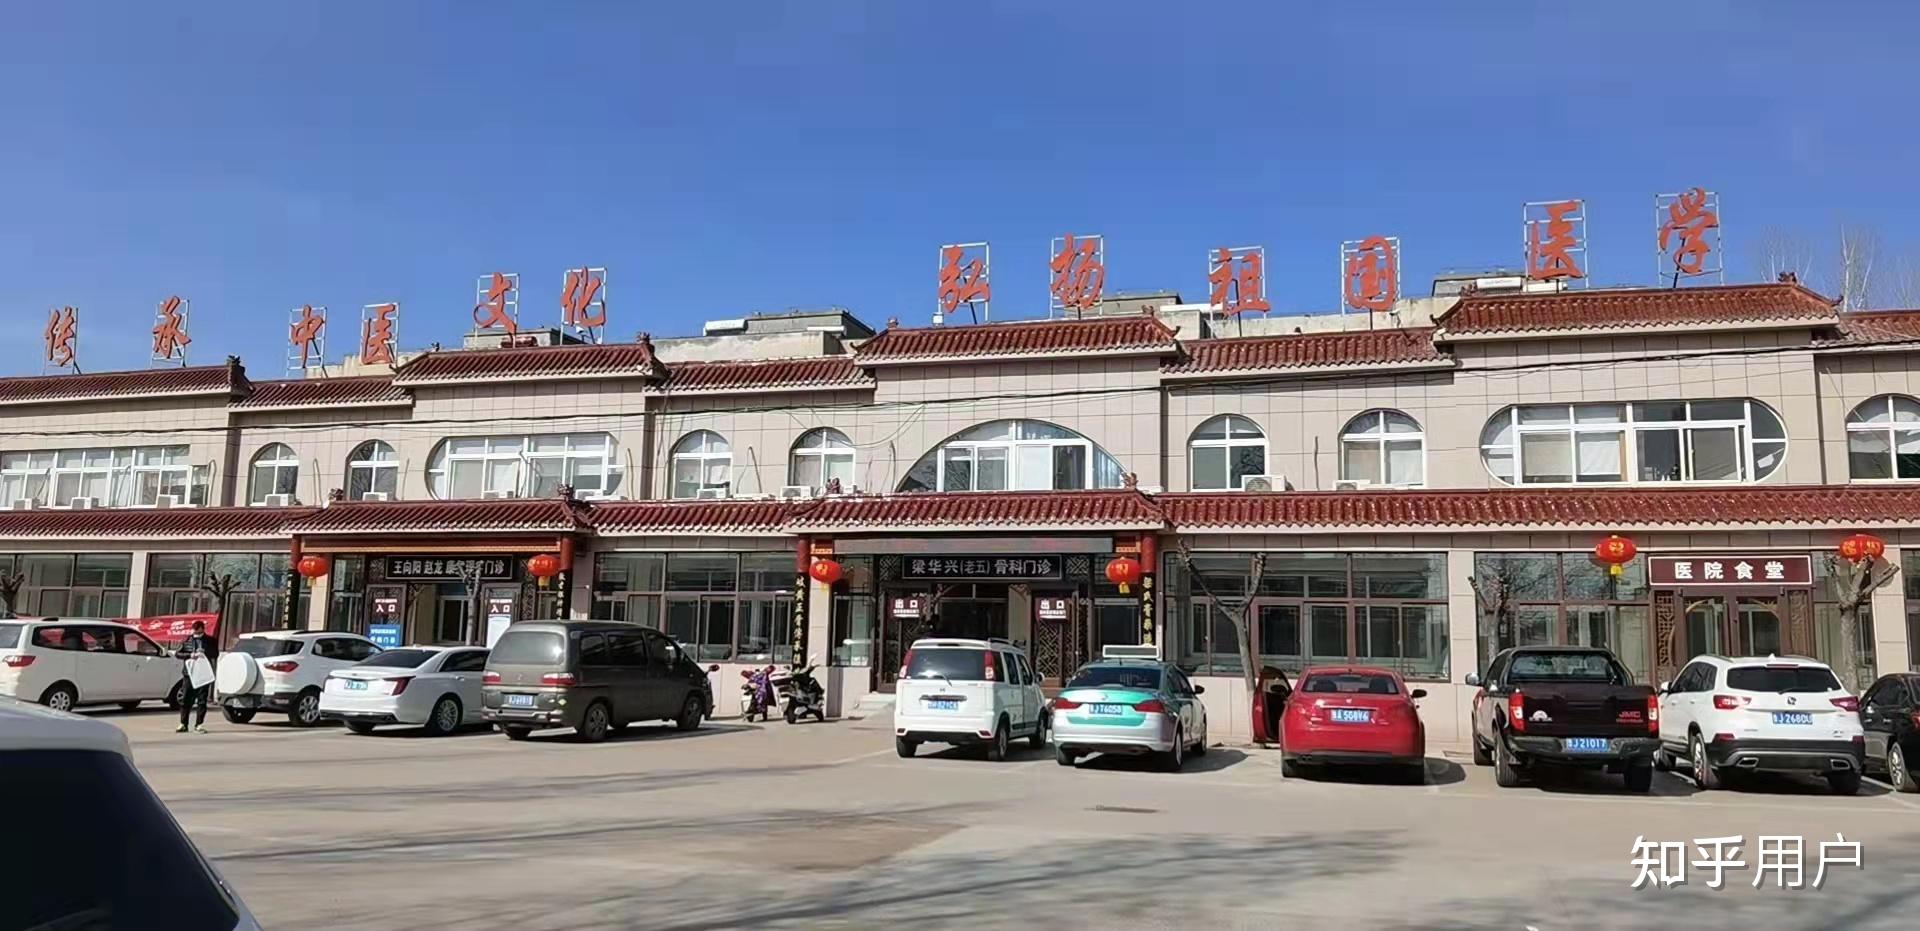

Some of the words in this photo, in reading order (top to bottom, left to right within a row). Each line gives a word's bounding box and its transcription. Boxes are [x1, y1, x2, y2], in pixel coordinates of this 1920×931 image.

[938, 187, 1719, 316] 弘扬祖国医学
[44, 266, 606, 367] 传承中医文化
[393, 560, 422, 575] 王向阳
[424, 560, 443, 575] 赵龙
[994, 559, 1052, 575] 骨科门诊
[1674, 561, 1785, 579] 医院食堂
[376, 604, 396, 613] 入口
[490, 604, 511, 613] 入口
[895, 599, 918, 608] 出口
[1040, 599, 1065, 609] 出口
